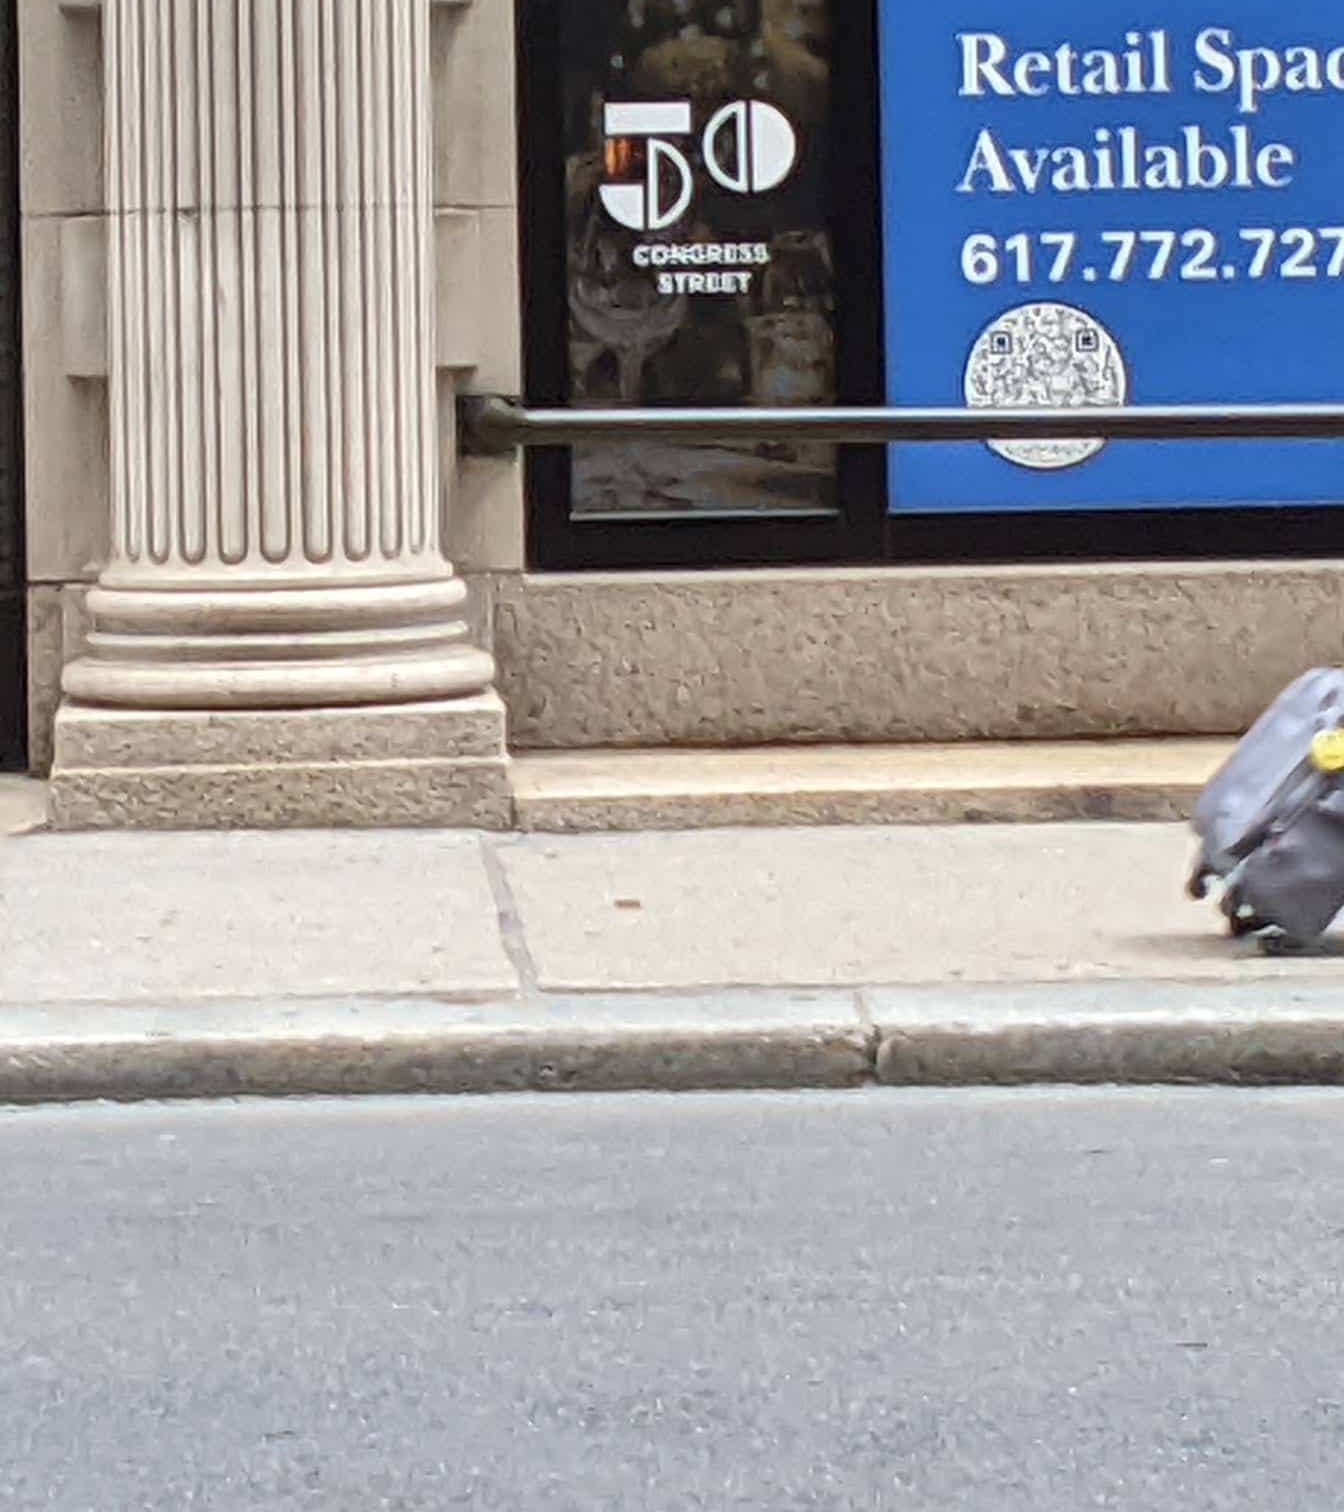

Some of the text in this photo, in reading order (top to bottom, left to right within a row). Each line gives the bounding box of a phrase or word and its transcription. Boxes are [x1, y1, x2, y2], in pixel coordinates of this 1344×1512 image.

[956, 28, 1171, 97] Retail
[599, 99, 796, 231] 50
[956, 125, 1294, 193] Available
[632, 242, 771, 267] CONGRESS
[657, 271, 753, 294] STREET
